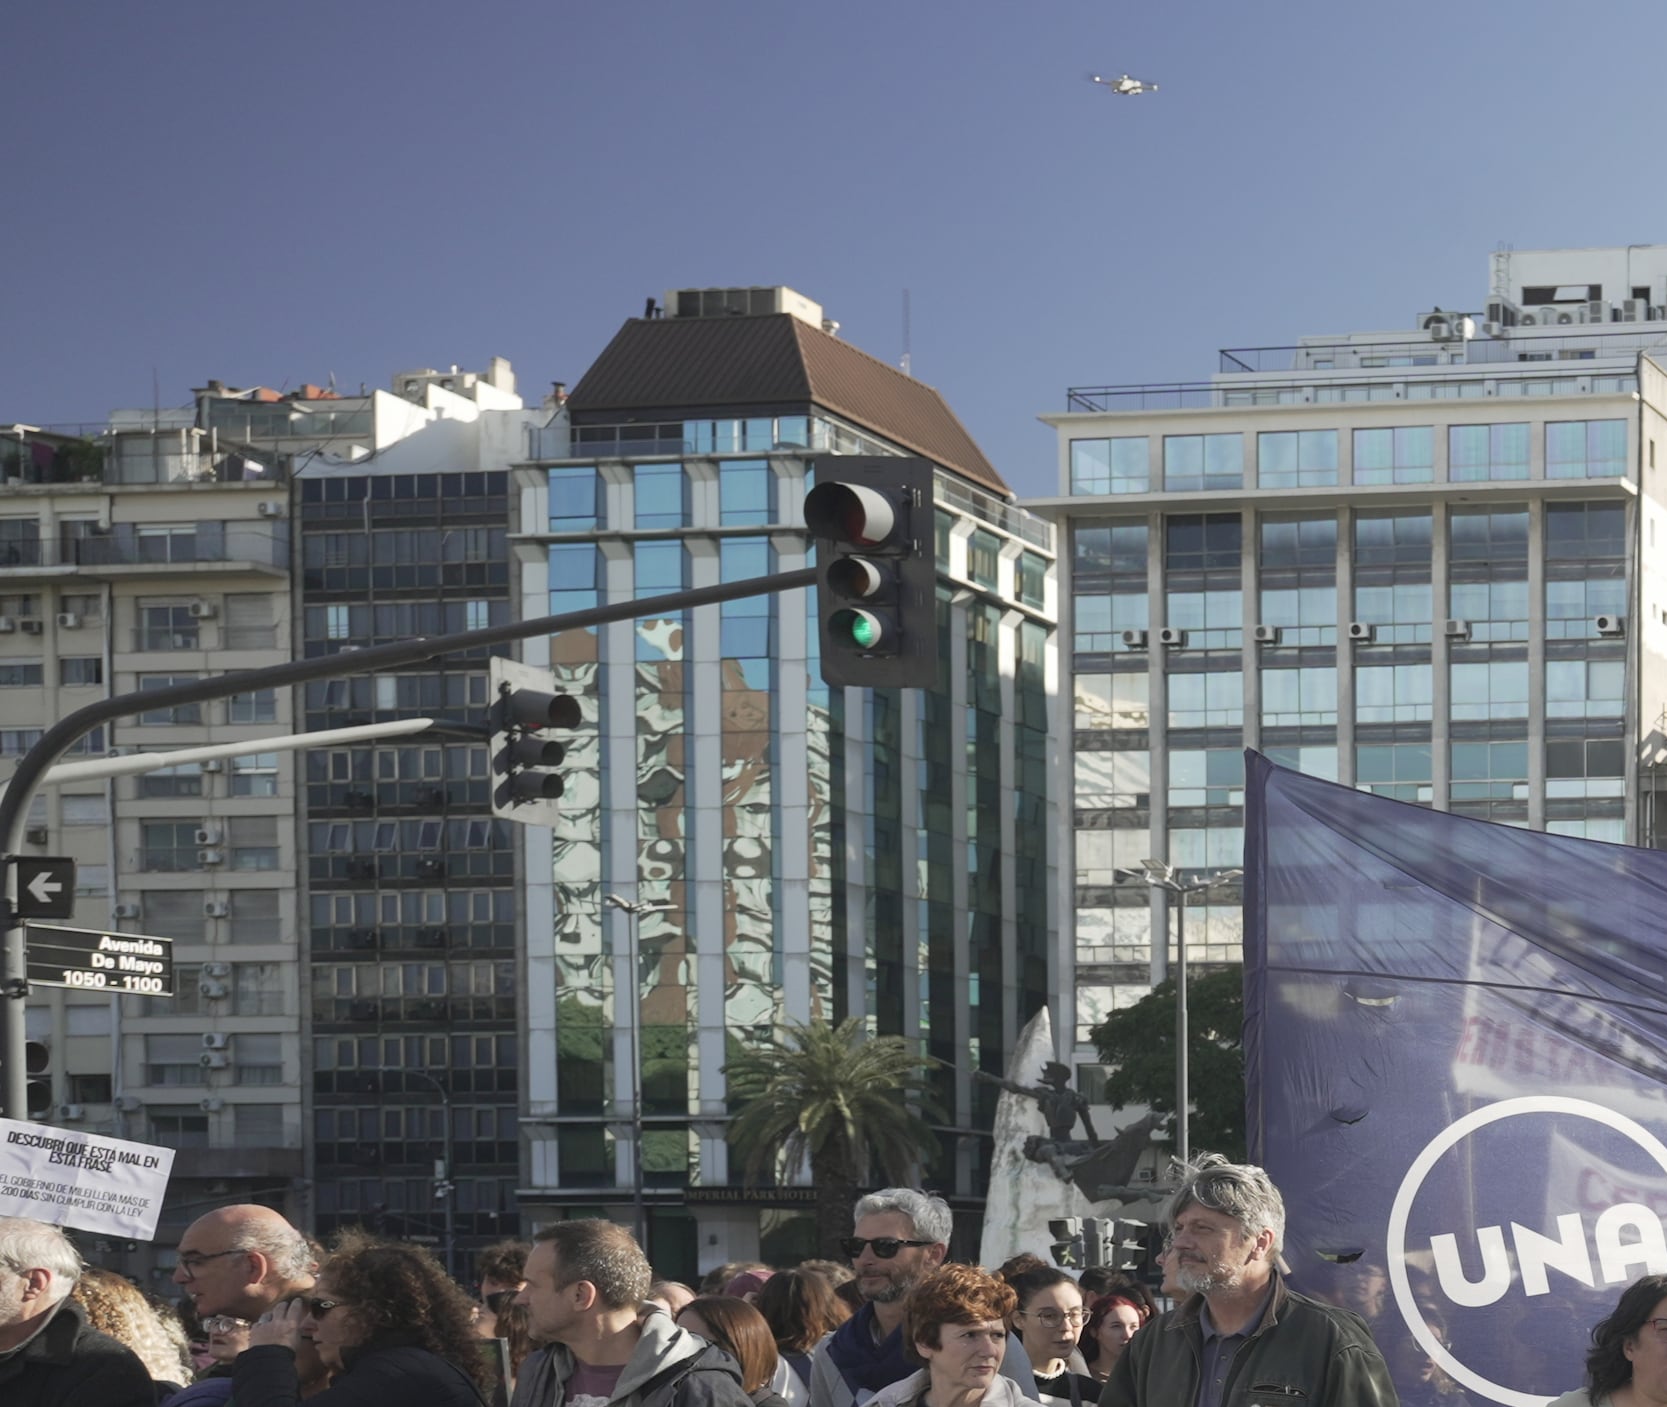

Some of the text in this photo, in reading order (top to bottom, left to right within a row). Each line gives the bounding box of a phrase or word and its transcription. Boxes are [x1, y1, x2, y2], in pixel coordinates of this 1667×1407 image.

[99, 936, 163, 956] Avenida
[92, 954, 163, 975] De Mayo
[63, 970, 106, 987] 1050
[123, 976, 163, 992] 1100
[49, 1151, 113, 1173] ESTA FRASE
[66, 1141, 88, 1155] QUE
[90, 1145, 116, 1162] ESTÁ
[118, 1151, 141, 1166] MAL
[144, 1155, 160, 1169] EN
[11, 1176, 55, 1192] GOBIERNO
[56, 1183, 69, 1194] DE
[93, 1189, 117, 1202] LLEVA
[119, 1191, 137, 1207] MÁS
[138, 1198, 150, 1209] DE
[40, 1192, 56, 1203] SIN
[56, 1195, 96, 1210] CUMPLIR
[96, 1201, 115, 1213] CON
[115, 1204, 126, 1215] LA
[127, 1206, 143, 1217] LEY
